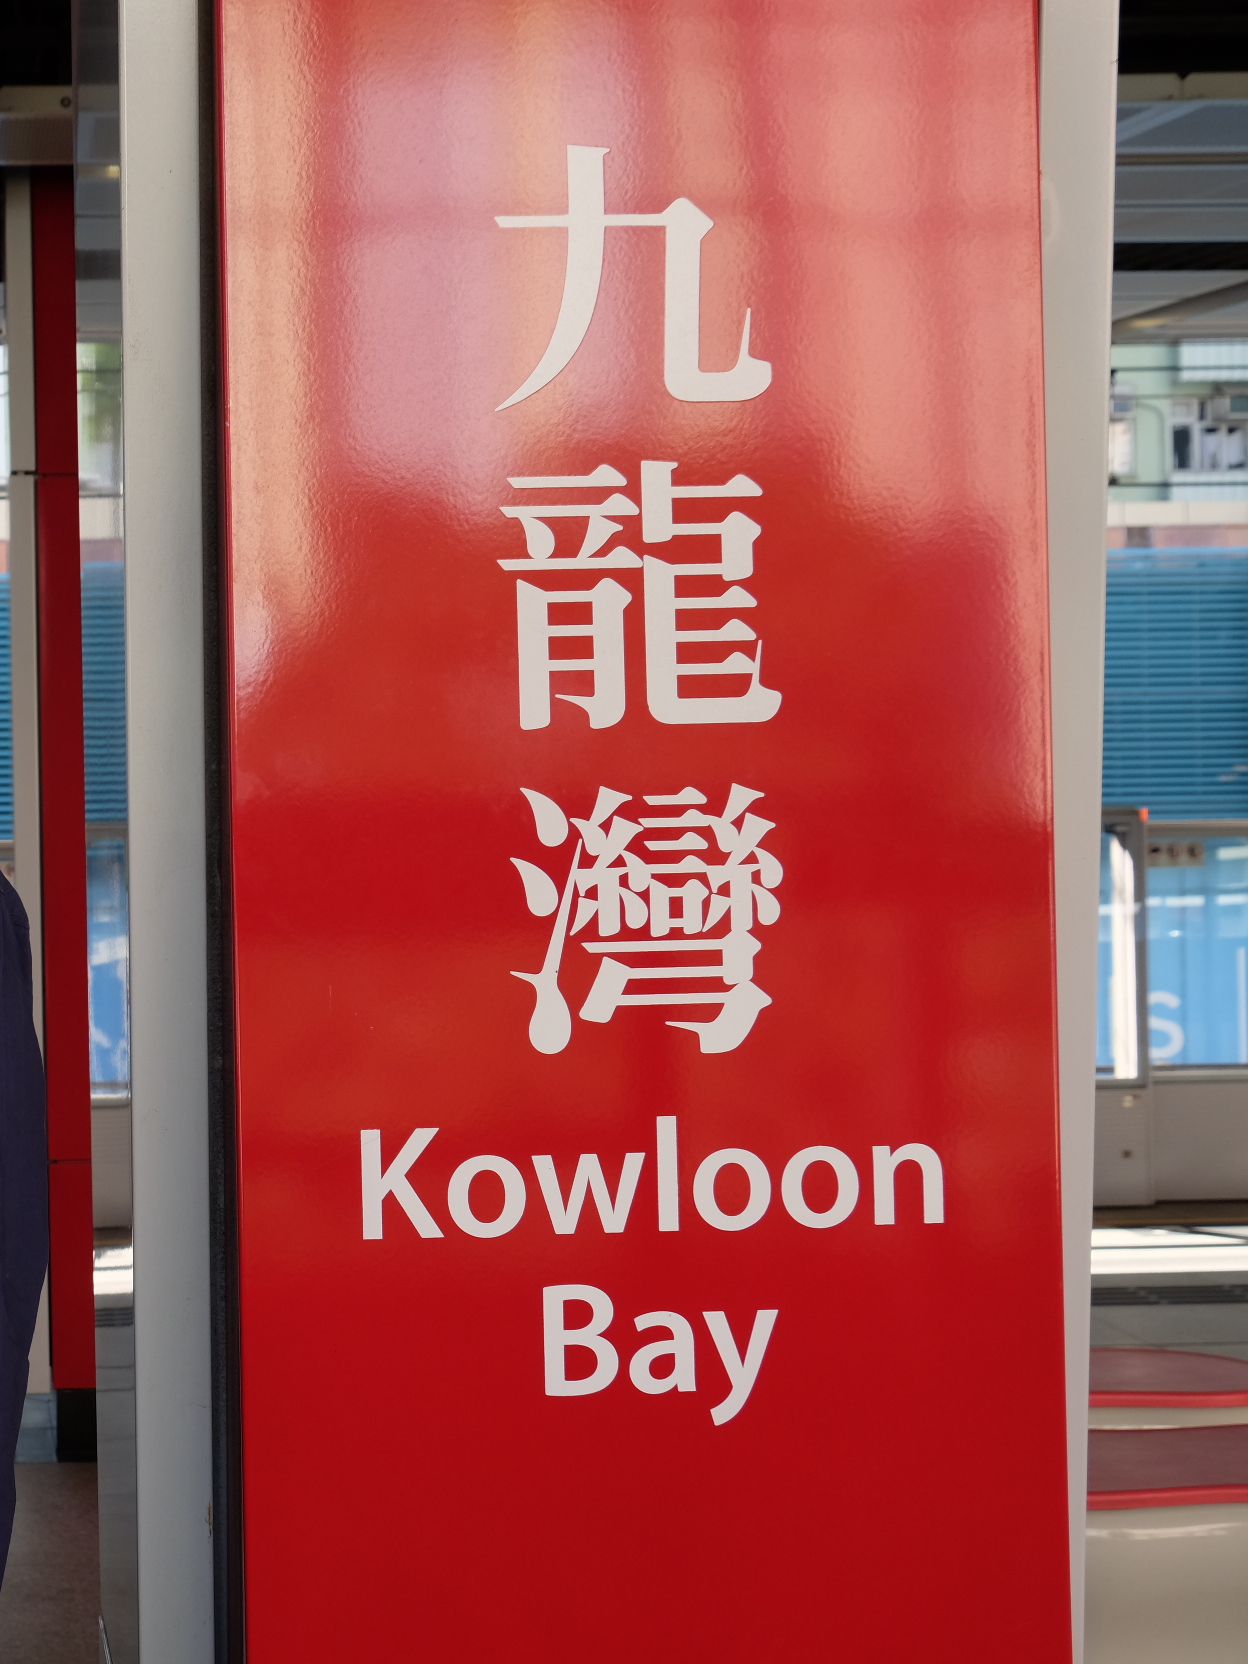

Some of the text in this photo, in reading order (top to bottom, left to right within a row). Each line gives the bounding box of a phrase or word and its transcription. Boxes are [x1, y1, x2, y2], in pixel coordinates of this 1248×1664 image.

[495, 145, 784, 1055] 九龍灣
[361, 1115, 945, 1240] Kowloon
[543, 1284, 779, 1426] Bay
